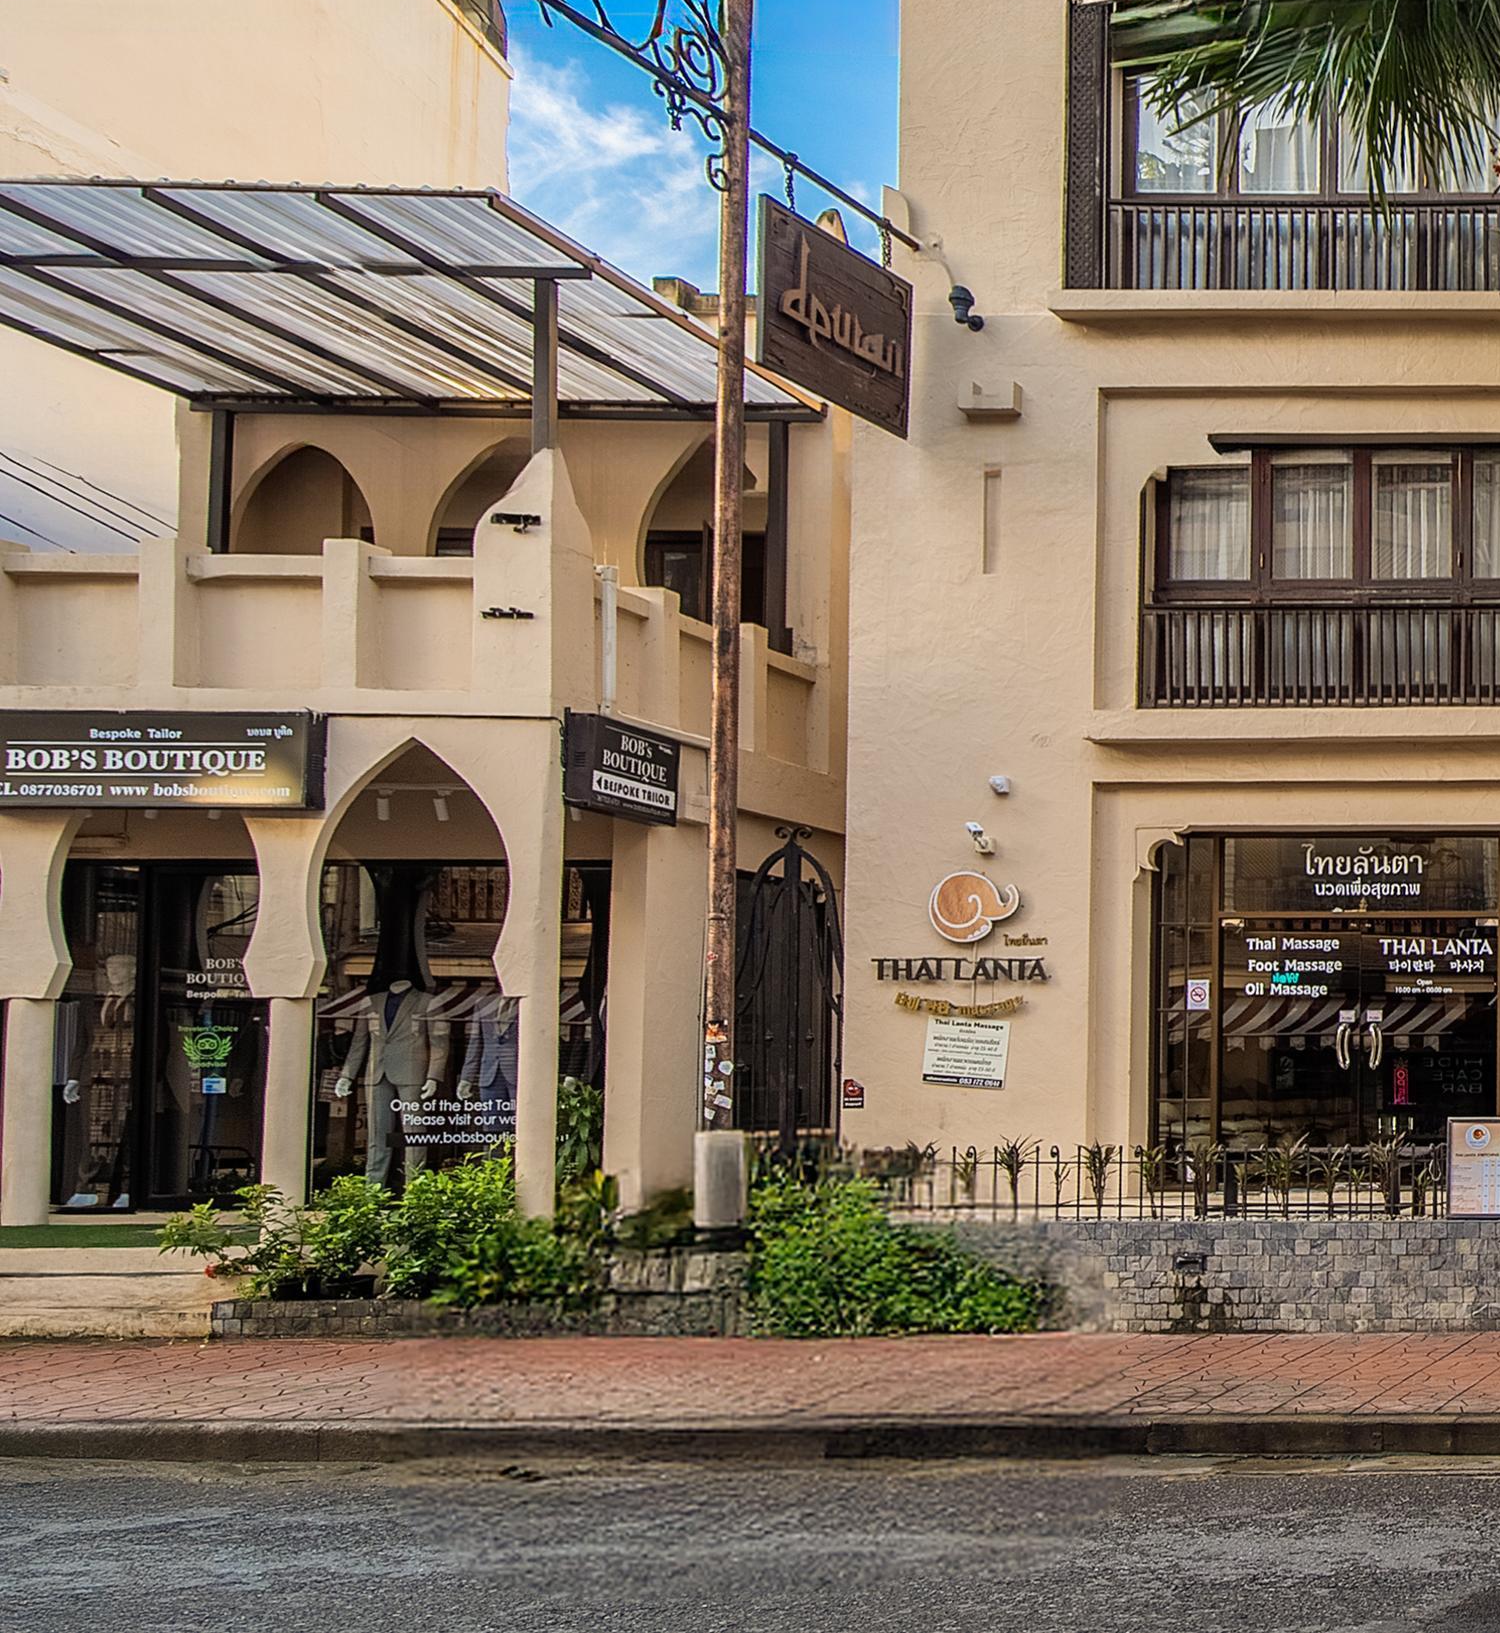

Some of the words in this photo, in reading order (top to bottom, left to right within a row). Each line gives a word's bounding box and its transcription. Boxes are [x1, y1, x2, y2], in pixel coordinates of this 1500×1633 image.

[89, 728, 142, 740] Bespoke
[147, 728, 183, 739] Tailor
[103, 750, 266, 776] BOUTIQUE
[602, 749, 667, 782] BOUTIQUE
[19, 784, 103, 797] 0877036701
[603, 778, 640, 799] BESPOKE
[642, 789, 671, 806] TAILOR
[1301, 843, 1423, 875] ไทยลันตา
[1314, 876, 1421, 900] นวดเพื่อสุขภาพ
[1245, 937, 1277, 950] Thai
[1281, 937, 1340, 952] Massage
[1379, 938, 1426, 955] THAI
[1431, 938, 1493, 955] LANTA
[871, 957, 946, 981] THAI
[951, 957, 1049, 981] LANTA
[1247, 959, 1280, 972] Foot
[1284, 959, 1343, 974] Massage
[1449, 959, 1485, 973] 마사지
[1245, 982, 1265, 995] Oil
[1269, 983, 1328, 998] Massage
[1416, 978, 1433, 987] Open
[973, 1021, 1004, 1031] Massage
[390, 1099, 420, 1112] One
[423, 1099, 437, 1111] of
[438, 1099, 462, 1111] the
[464, 1099, 493, 1111] best
[402, 1114, 446, 1126] Please
[448, 1114, 471, 1125] visit
[474, 1116, 496, 1125] our
